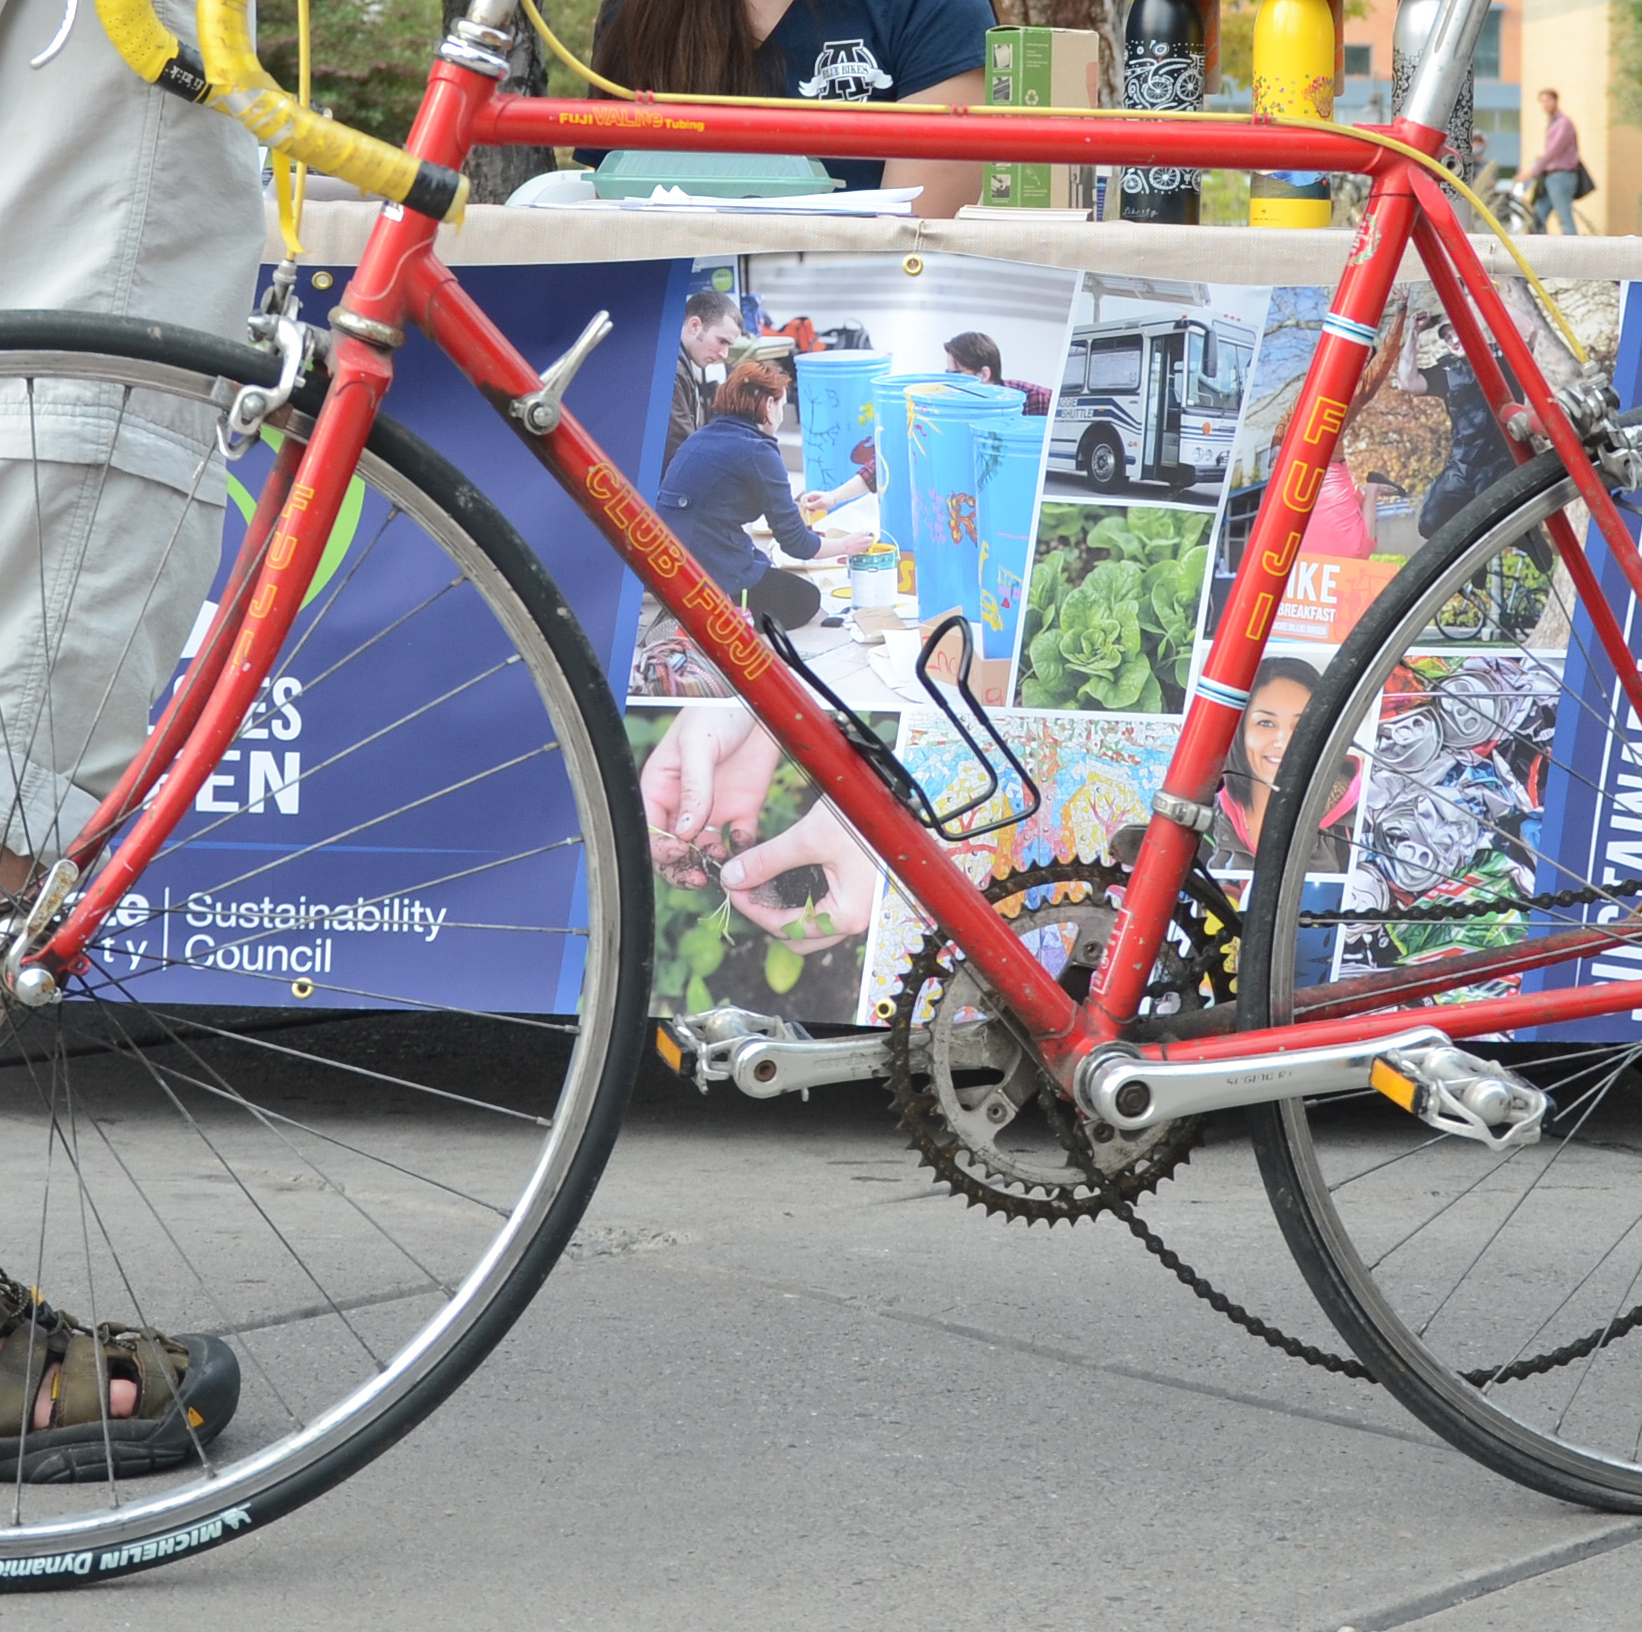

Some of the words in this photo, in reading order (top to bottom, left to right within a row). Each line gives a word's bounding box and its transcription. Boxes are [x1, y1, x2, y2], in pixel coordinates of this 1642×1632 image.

[841, 63, 870, 76] BIKES
[559, 112, 593, 125] FUJI
[665, 118, 705, 132] Tubing
[1245, 396, 1348, 641] FUJI
[230, 483, 314, 667] FUJI
[586, 462, 688, 578] CLUB
[683, 577, 774, 680] FUJI
[1285, 561, 1341, 604] IKE
[1277, 602, 1336, 623] BREAKFAST
[185, 892, 447, 942] Sustainability
[184, 934, 332, 973] Council
[99, 1519, 222, 1571] MICHELIN
